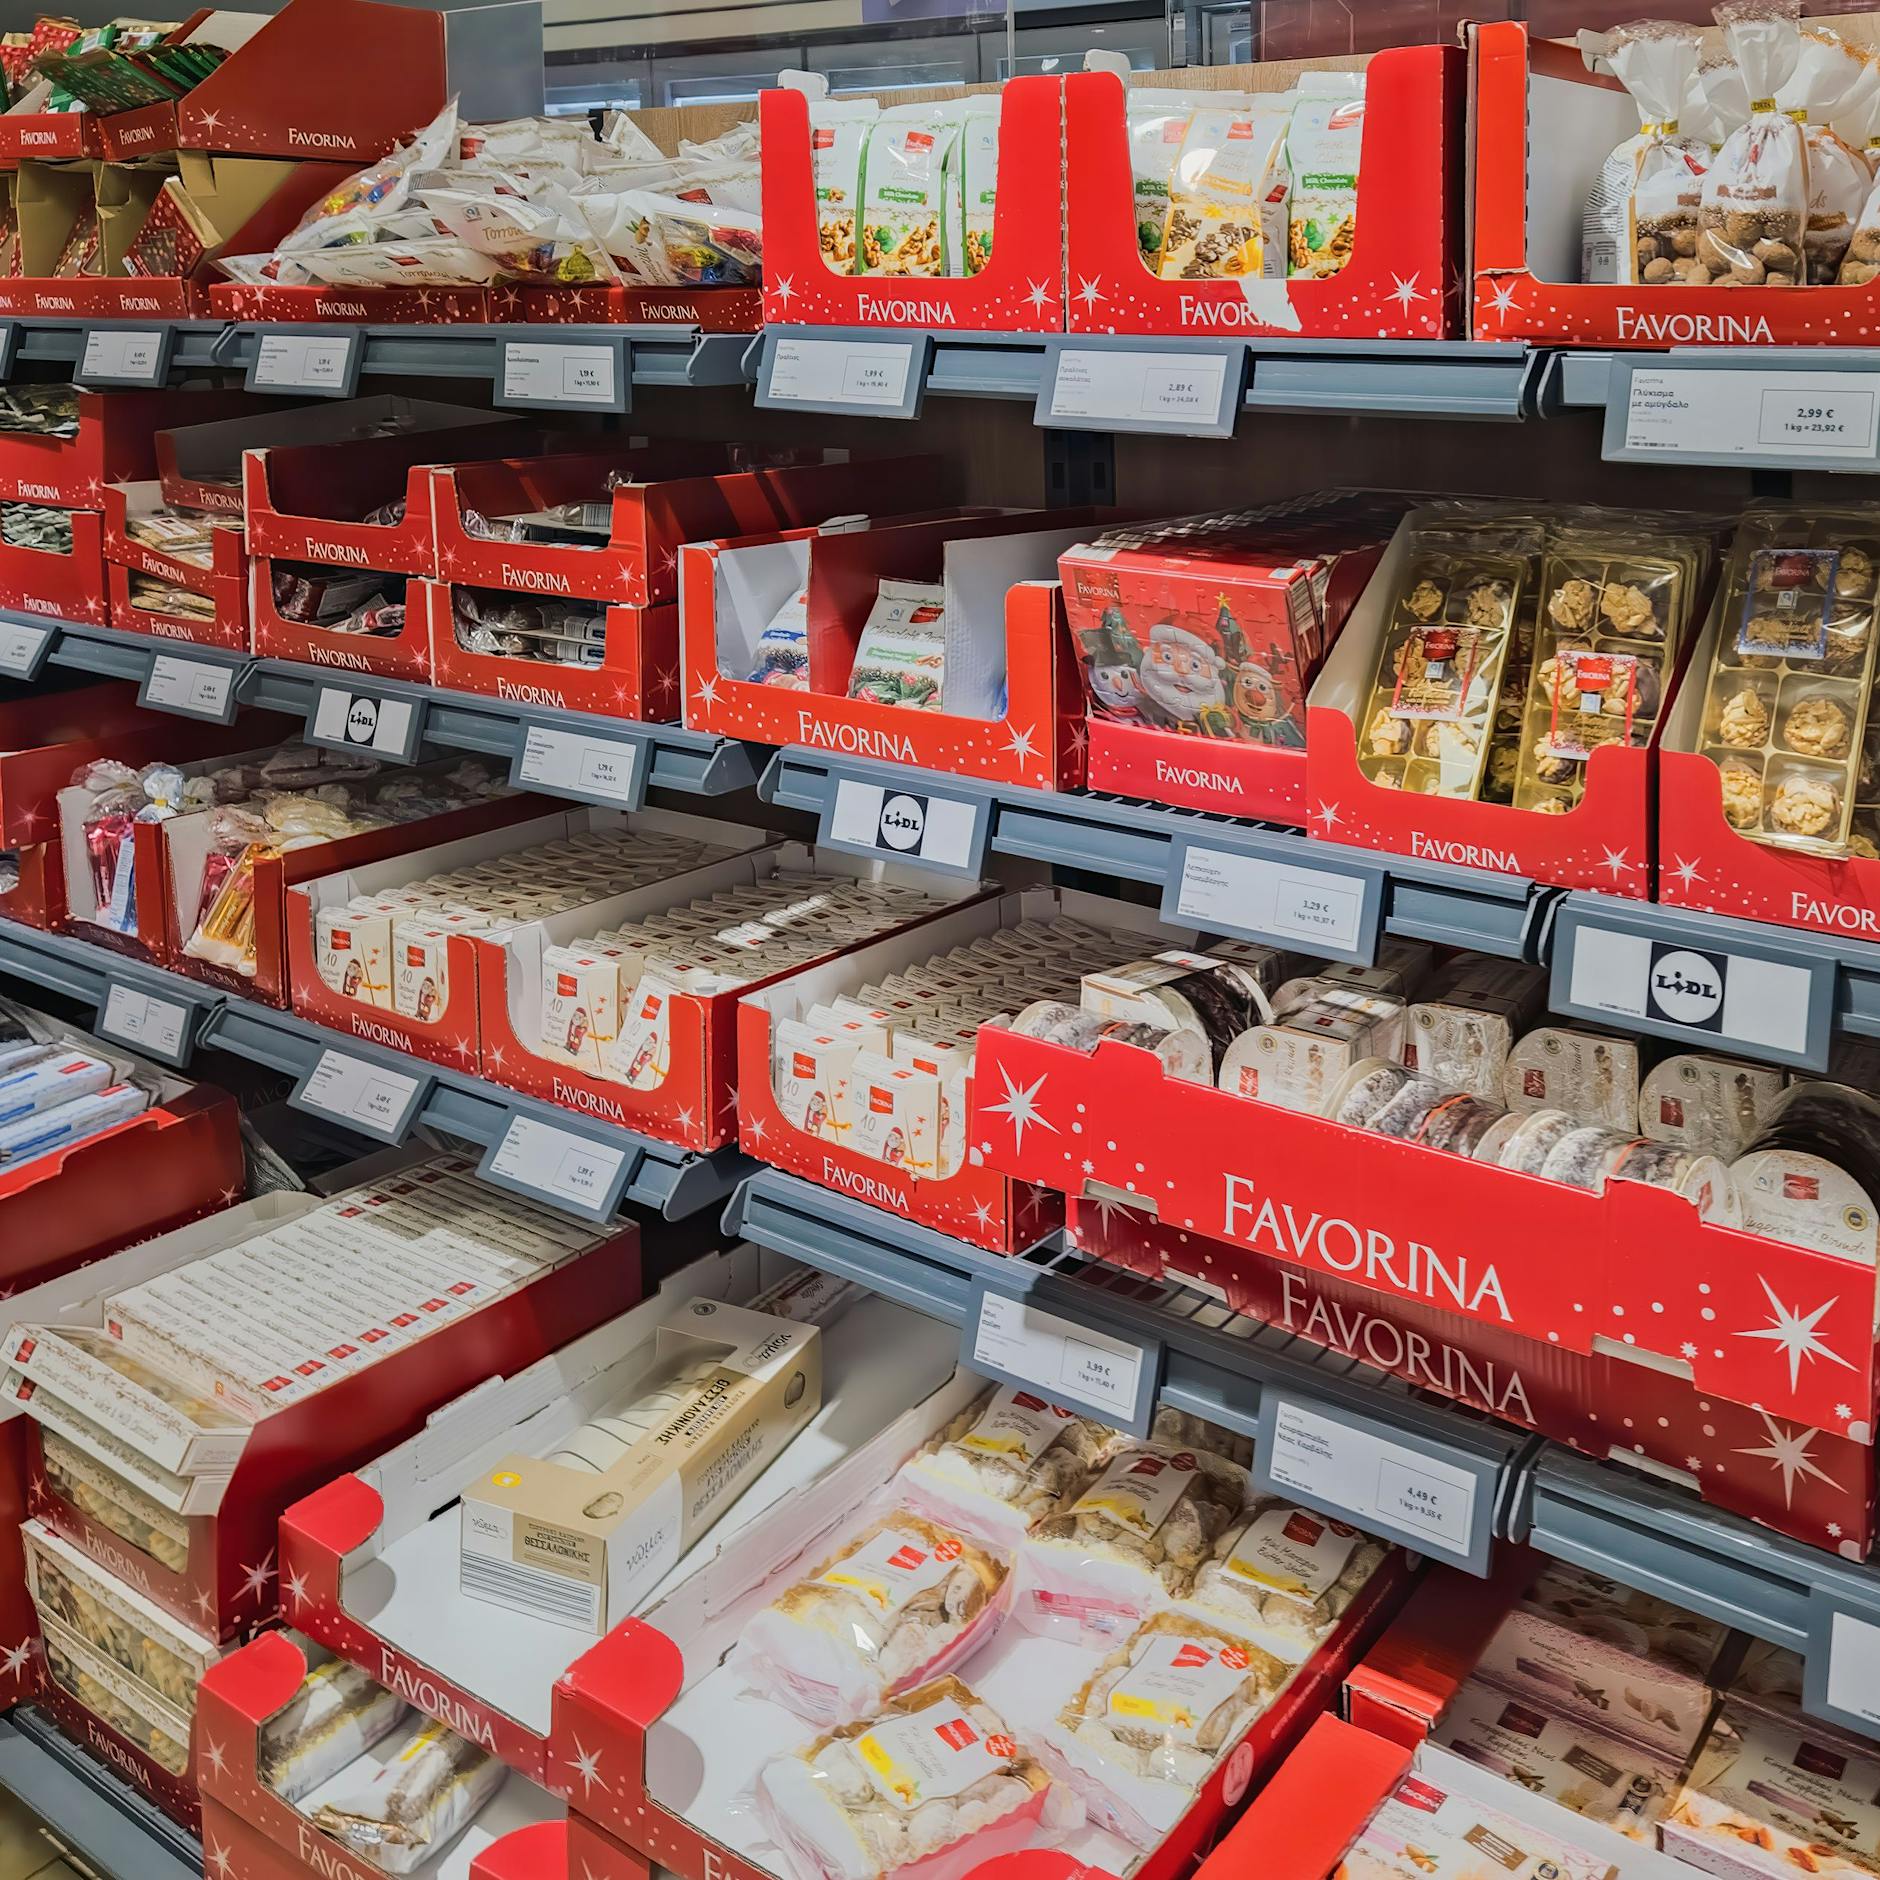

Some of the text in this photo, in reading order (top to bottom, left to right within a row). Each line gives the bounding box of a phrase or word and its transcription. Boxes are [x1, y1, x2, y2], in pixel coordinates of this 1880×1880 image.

[20, 129, 58, 145] FAVORINA
[119, 126, 155, 145] FAVORINA
[288, 128, 356, 150] FAVORINA
[35, 293, 75, 310] FAVORINA
[119, 294, 161, 311] FAVORINA
[315, 298, 368, 317] FAVORINA
[640, 301, 699, 320] FAVORINA
[857, 294, 956, 325] FAVORINA
[1616, 307, 1775, 344] FAVORINA
[1187, 384, 1192, 392] €
[1797, 408, 1834, 420] 2,99 €
[1791, 424, 1802, 433] kg
[1811, 424, 1836, 433] 23,92
[17, 479, 60, 501] FAVORINA
[305, 536, 370, 565] FAVORINA
[142, 552, 186, 584] FAVORINA
[502, 563, 571, 593] FAVORINA
[1077, 582, 1120, 600] FAVORINA
[24, 594, 63, 617] FAVORINA
[150, 617, 195, 642] FAVORINA
[308, 641, 372, 672] FAVORINA
[497, 677, 566, 709] FAVORINA
[797, 710, 919, 764] FAVORINA
[1155, 759, 1244, 796] FAVORINA
[1410, 831, 1521, 875] FAVORINA
[1322, 904, 1328, 912] €
[1791, 891, 1880, 934] FAVOR
[324, 952, 338, 967] 10
[400, 969, 413, 984] 10
[550, 998, 563, 1014] 10
[351, 1012, 413, 1054] FAVORINA
[553, 1076, 625, 1122] FAVORINA
[783, 1079, 799, 1097] 10
[861, 1113, 876, 1132] 10
[822, 1157, 910, 1213] FAVORINA
[1222, 1172, 1515, 1323] FAVORINA
[1279, 1269, 1539, 1426] FAVORINA
[1104, 1367, 1111, 1377] €
[655, 1378, 731, 1447] ΘΕΣΣΑΛΟΝΙΚΗΣ
[1407, 1486, 1438, 1506] 4,49 €
[84, 1526, 151, 1590] FAVORINA
[380, 1647, 498, 1754] FAVORINA
[87, 1719, 152, 1790] FAVORINA
